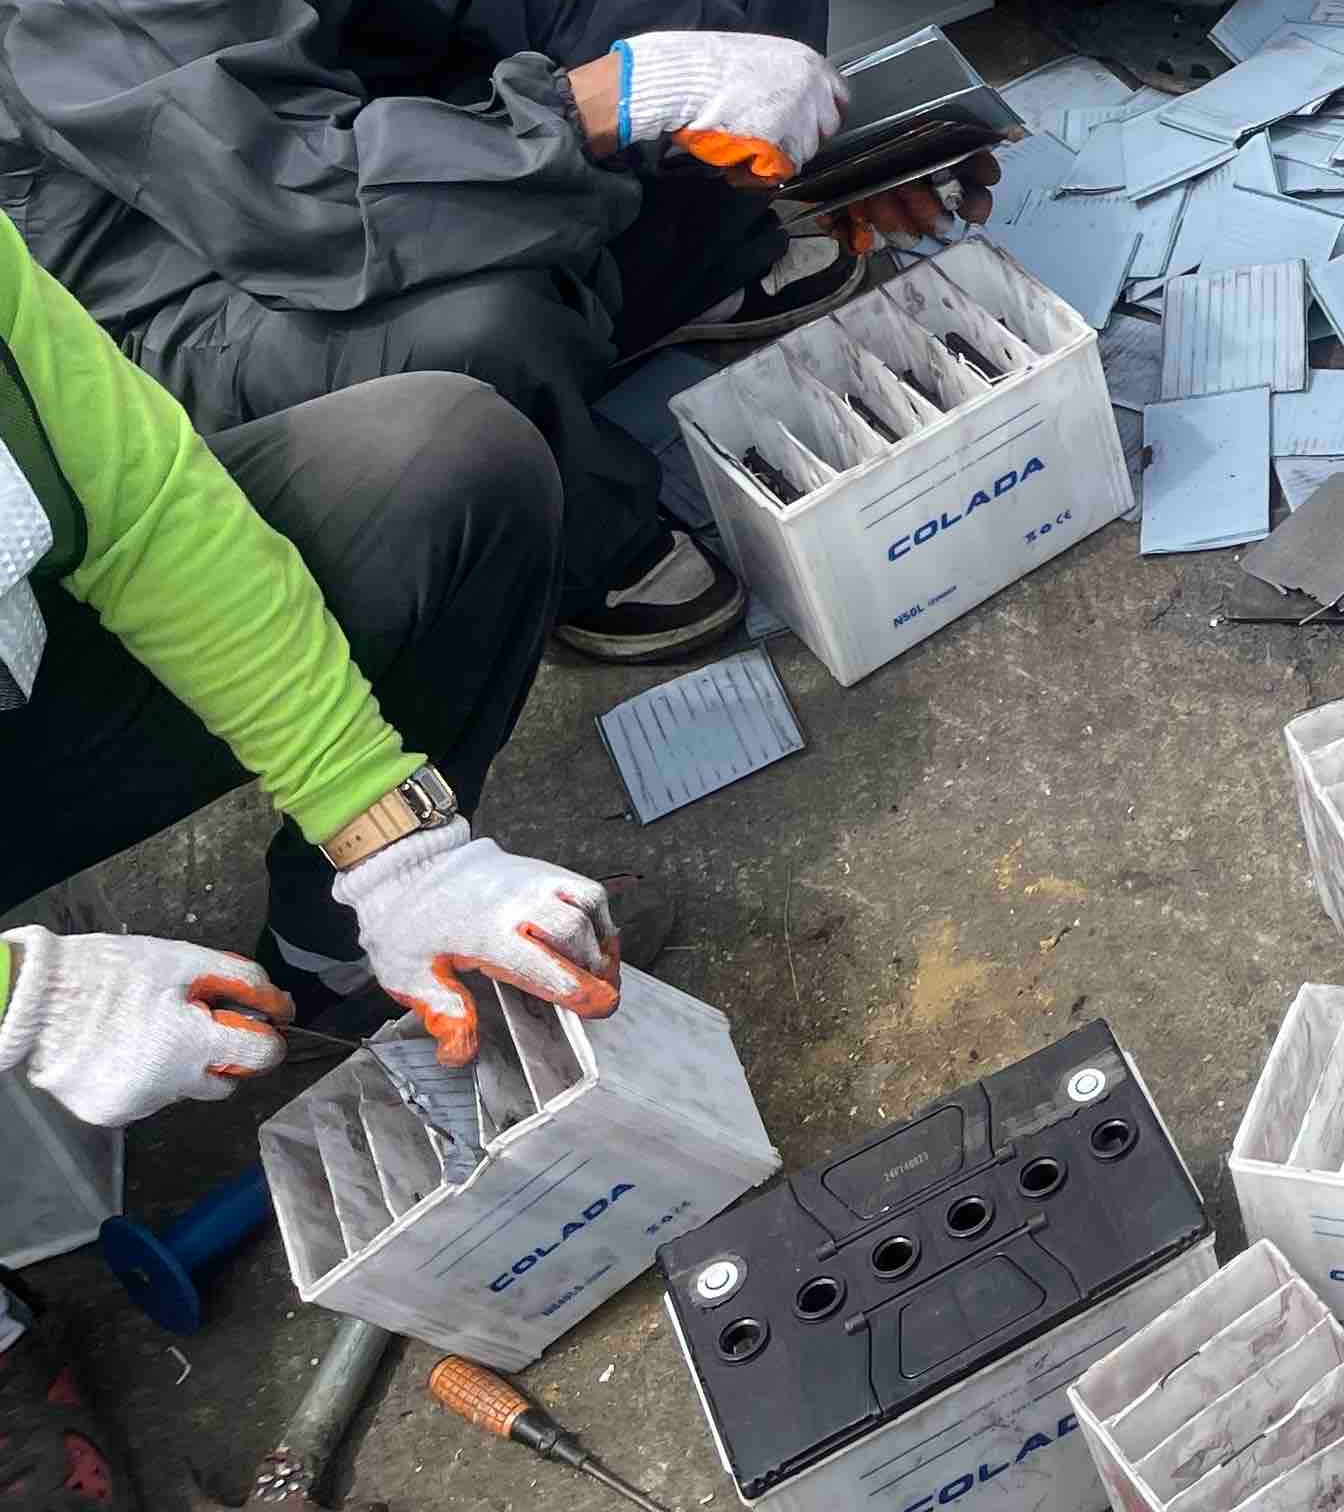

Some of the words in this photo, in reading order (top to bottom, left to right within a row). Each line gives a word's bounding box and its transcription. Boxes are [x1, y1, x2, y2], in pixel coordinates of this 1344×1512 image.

[887, 457, 1046, 562] COLADA
[489, 1183, 636, 1293] COLADA
[903, 1413, 1082, 1512] COLAD
